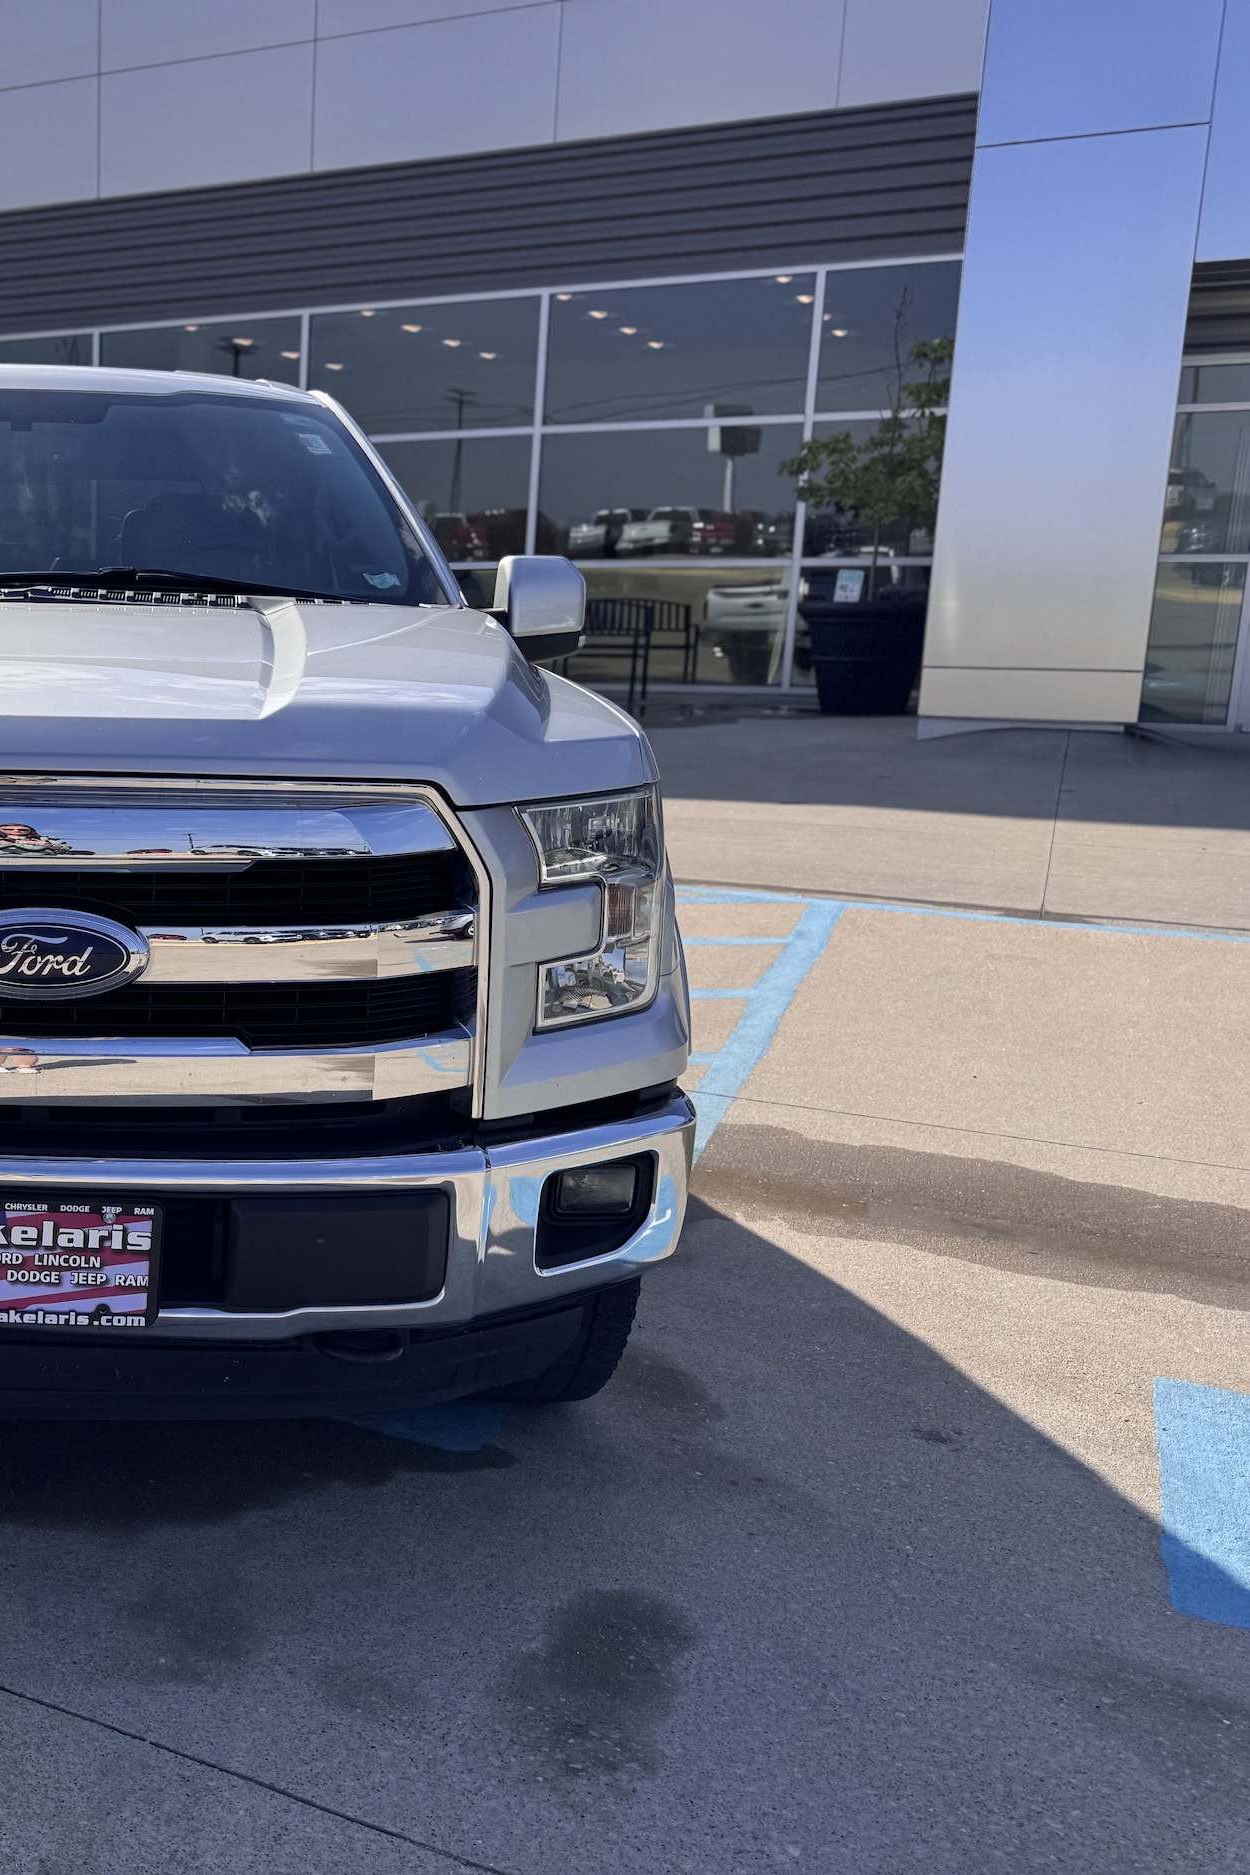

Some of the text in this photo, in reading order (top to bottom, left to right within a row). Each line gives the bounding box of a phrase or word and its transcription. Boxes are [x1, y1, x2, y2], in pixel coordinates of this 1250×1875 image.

[5, 1203, 48, 1212] CHRYSLER
[60, 1204, 90, 1213] DODGE
[101, 1206, 122, 1214] JEEP
[134, 1207, 155, 1215] RAM
[34, 1253, 101, 1268] LINCOLN
[6, 1269, 60, 1284] DODGE
[70, 1272, 107, 1286] JEEP
[115, 1274, 149, 1288] RAM
